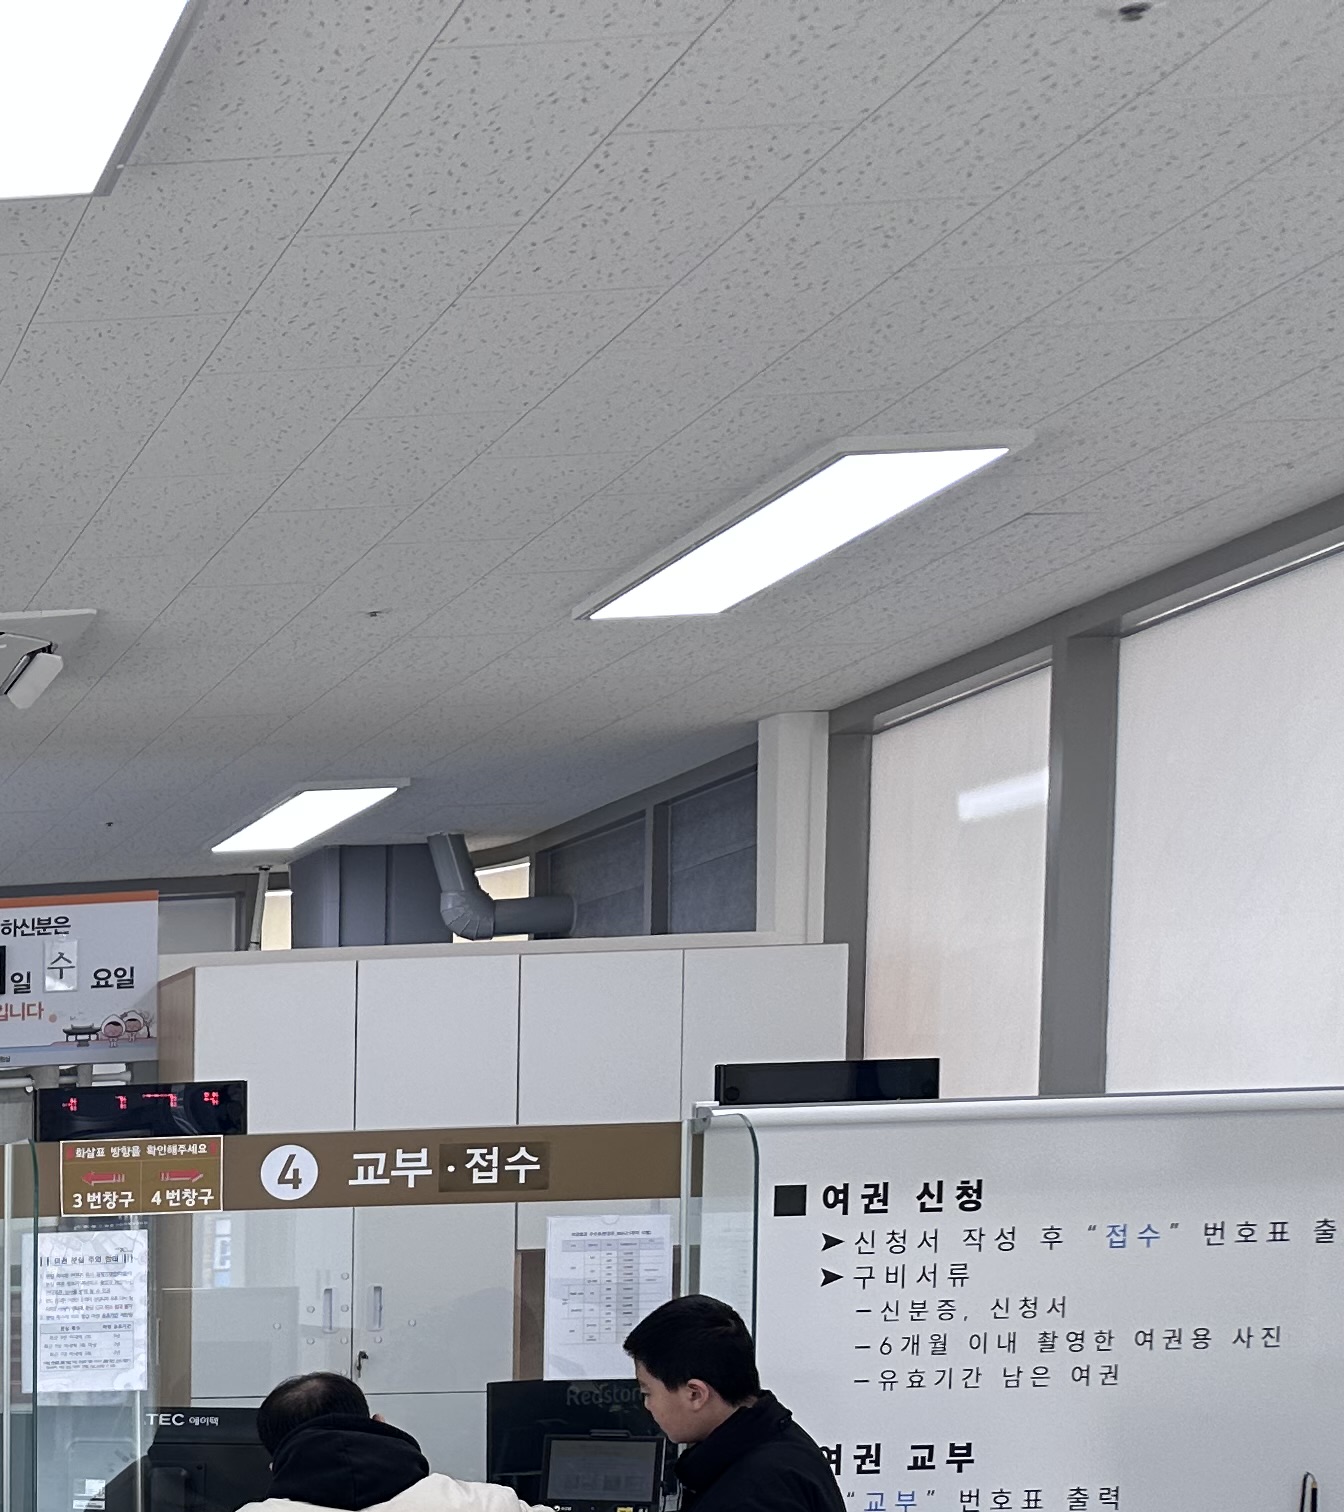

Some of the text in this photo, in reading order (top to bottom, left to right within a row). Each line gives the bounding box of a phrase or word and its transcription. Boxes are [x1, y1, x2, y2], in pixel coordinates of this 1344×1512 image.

[1, 917, 71, 937] 하신분은
[47, 952, 76, 980] 수
[91, 967, 134, 989] 요일
[76, 1144, 207, 1158] 화살표 방향을 확인해주세요
[278, 1154, 302, 1189] 4
[73, 1192, 134, 1209] 3 번창구
[151, 1189, 214, 1206] 4 번창구
[823, 1179, 982, 1215] 여권 신청
[855, 1229, 937, 1254] 신청서
[963, 1227, 1015, 1252] 작성
[1041, 1226, 1063, 1250] 후
[1205, 1221, 1289, 1246] 번호표
[854, 1263, 969, 1289] 구비서류
[991, 1296, 1065, 1319] 신청서
[970, 1332, 1016, 1354] 이내
[1038, 1330, 1114, 1353] 촬영한
[1135, 1328, 1211, 1350] 여권용
[1233, 1326, 1280, 1348] 사진
[1004, 1366, 1050, 1388] 남은
[1072, 1364, 1117, 1386] 여권
[144, 1413, 186, 1426] TEC
[907, 1443, 974, 1473] 교부
[960, 1489, 1043, 1512] 번호표
[1067, 1486, 1119, 1510] 출력
